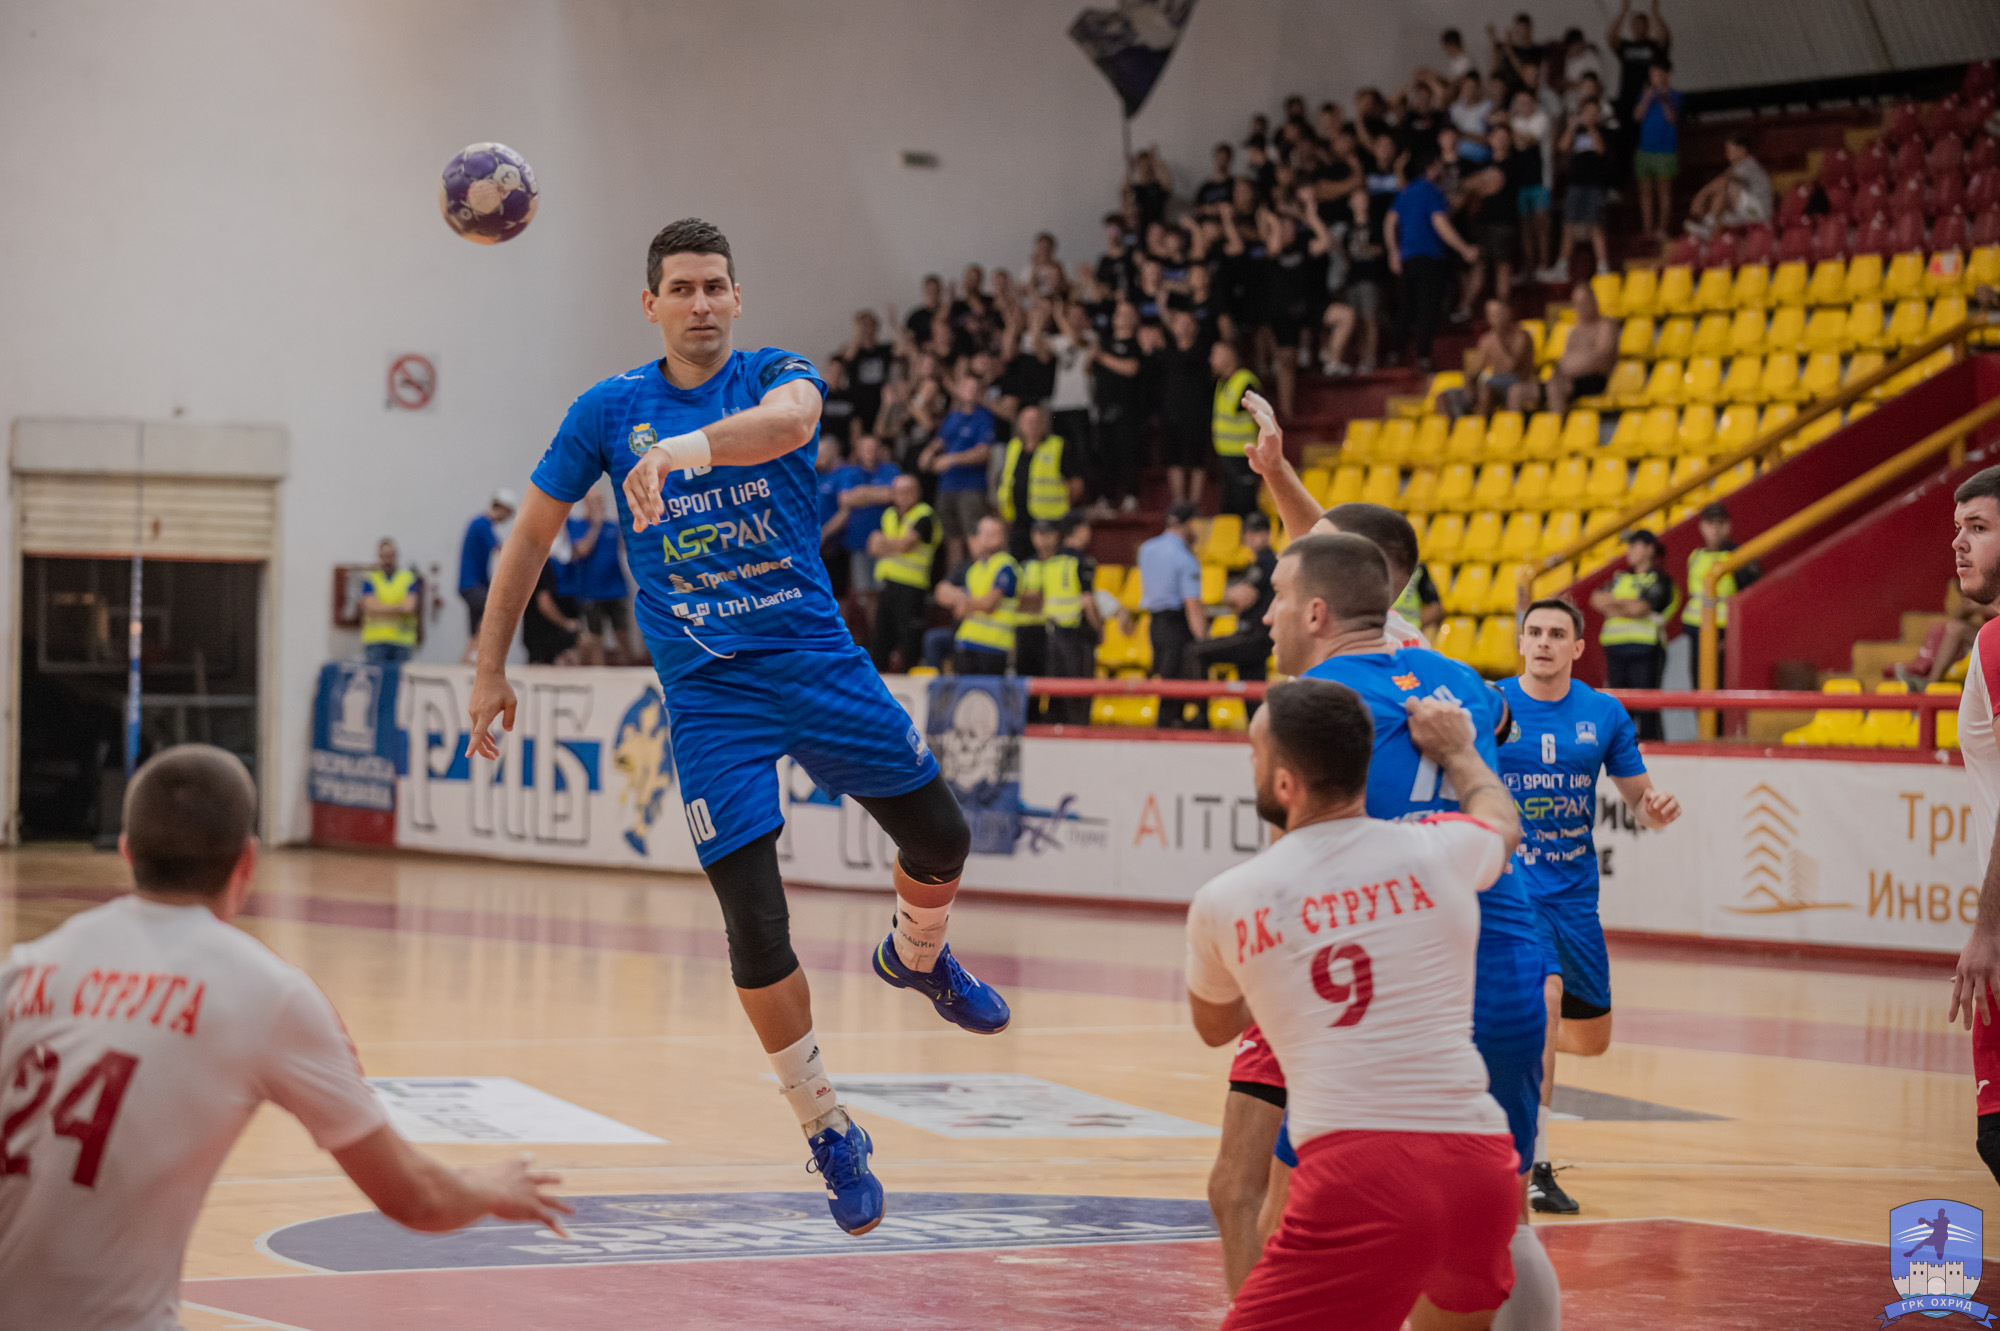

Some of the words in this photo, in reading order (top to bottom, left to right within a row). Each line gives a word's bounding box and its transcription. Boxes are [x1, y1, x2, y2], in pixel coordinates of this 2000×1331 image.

[667, 488, 723, 518] SPORT
[662, 508, 778, 564] ASPPAK
[717, 597, 751, 618] LTH
[1541, 732, 1557, 765] 6
[1522, 773, 1565, 791] SPORT
[685, 797, 717, 846] 10
[1301, 871, 1436, 935] СТРУГА
[1867, 868, 1981, 926] Инве
[71, 966, 207, 1037] СТРУГА
[1309, 942, 1375, 1029] 9
[0, 1042, 141, 1190] 24
